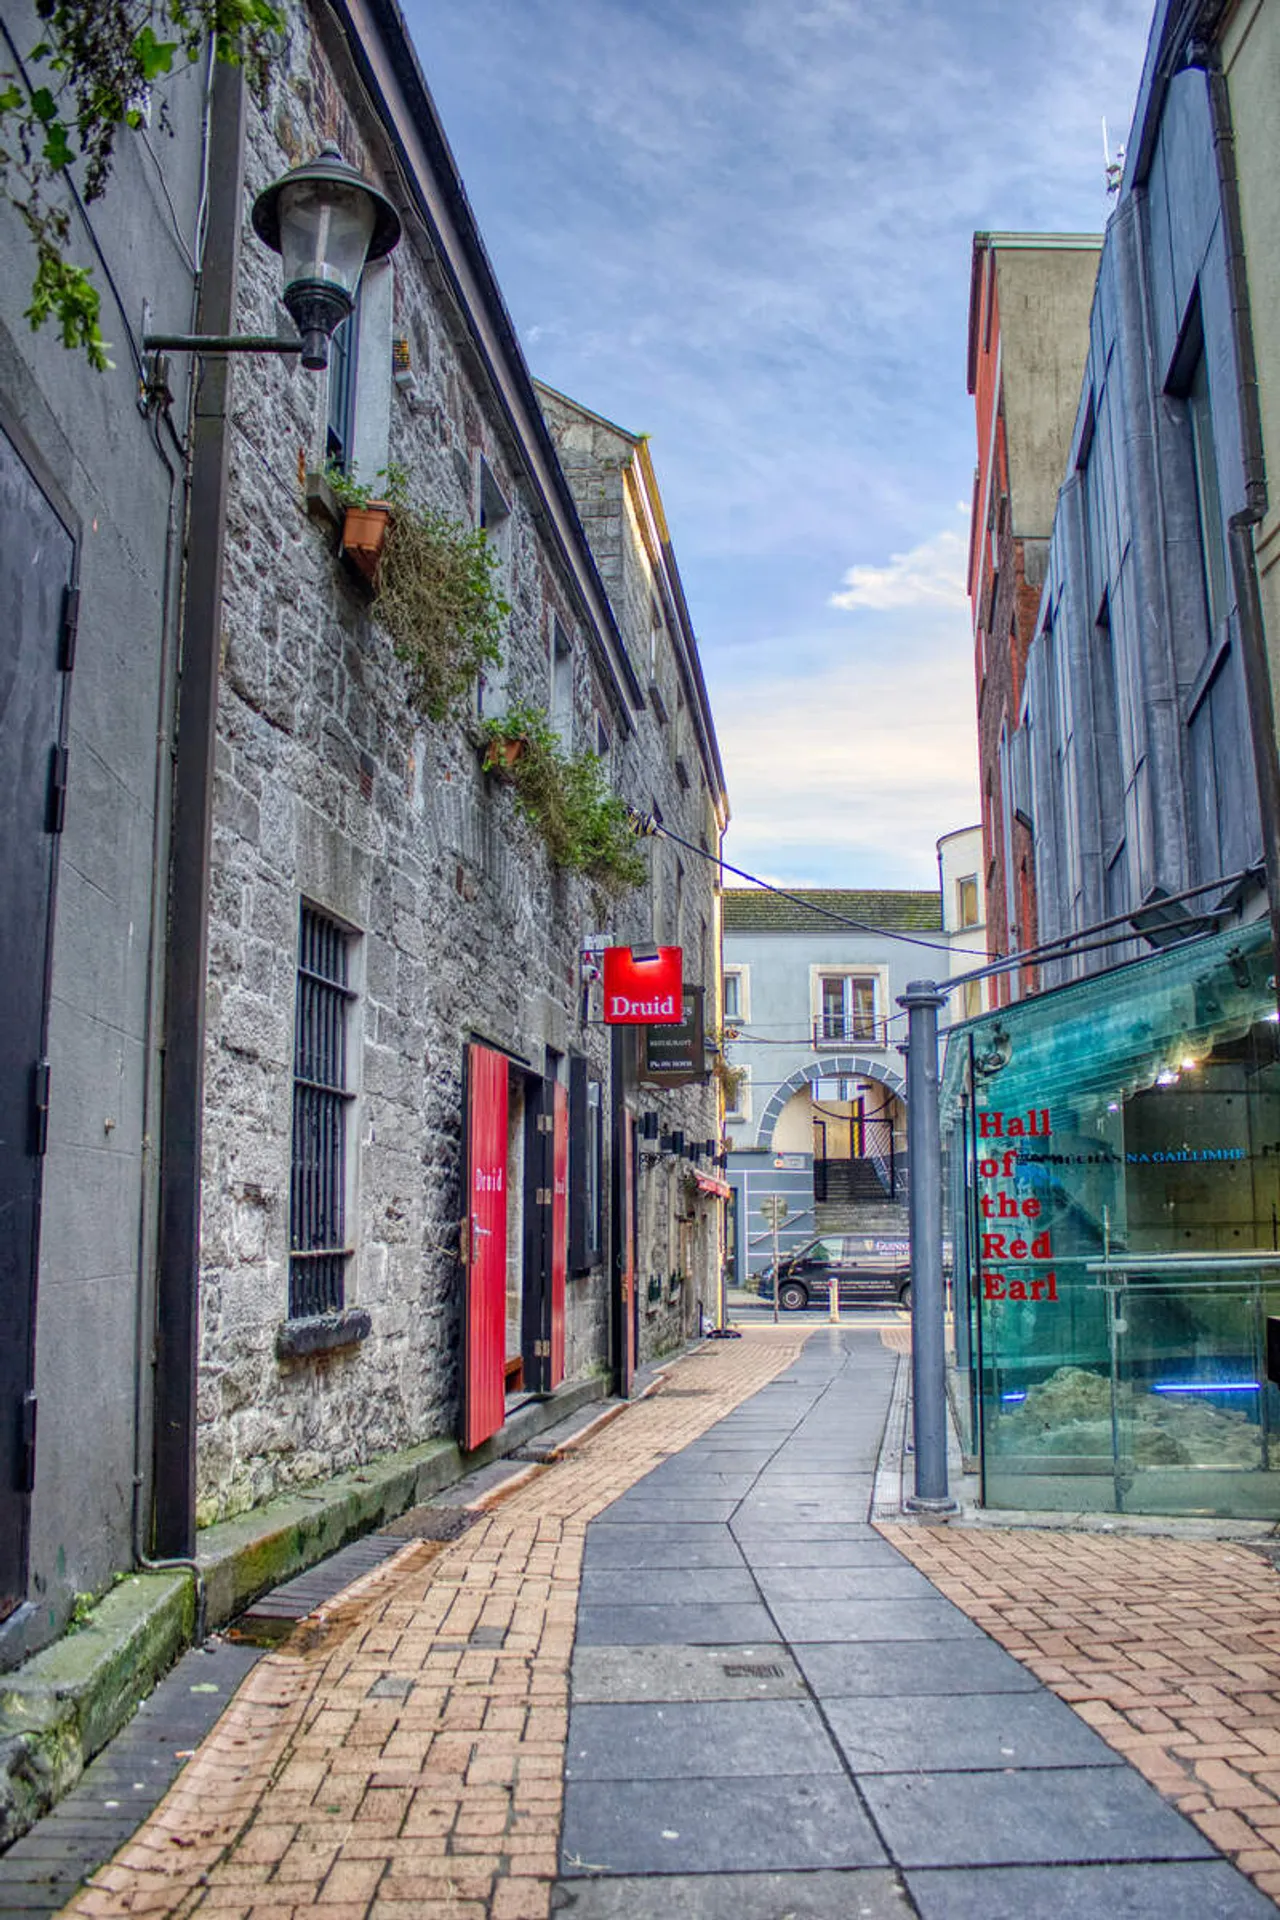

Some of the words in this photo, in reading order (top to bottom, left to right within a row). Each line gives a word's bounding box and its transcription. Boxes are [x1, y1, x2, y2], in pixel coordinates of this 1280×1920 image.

[611, 995, 674, 1016] Druid
[978, 1109, 1053, 1138] Hall
[979, 1150, 1018, 1178] of
[1126, 1152, 1150, 1163] NA
[476, 1167, 503, 1192] Druid
[981, 1192, 1042, 1218] the
[982, 1230, 1053, 1259] Red
[983, 1272, 1058, 1302] Earl
